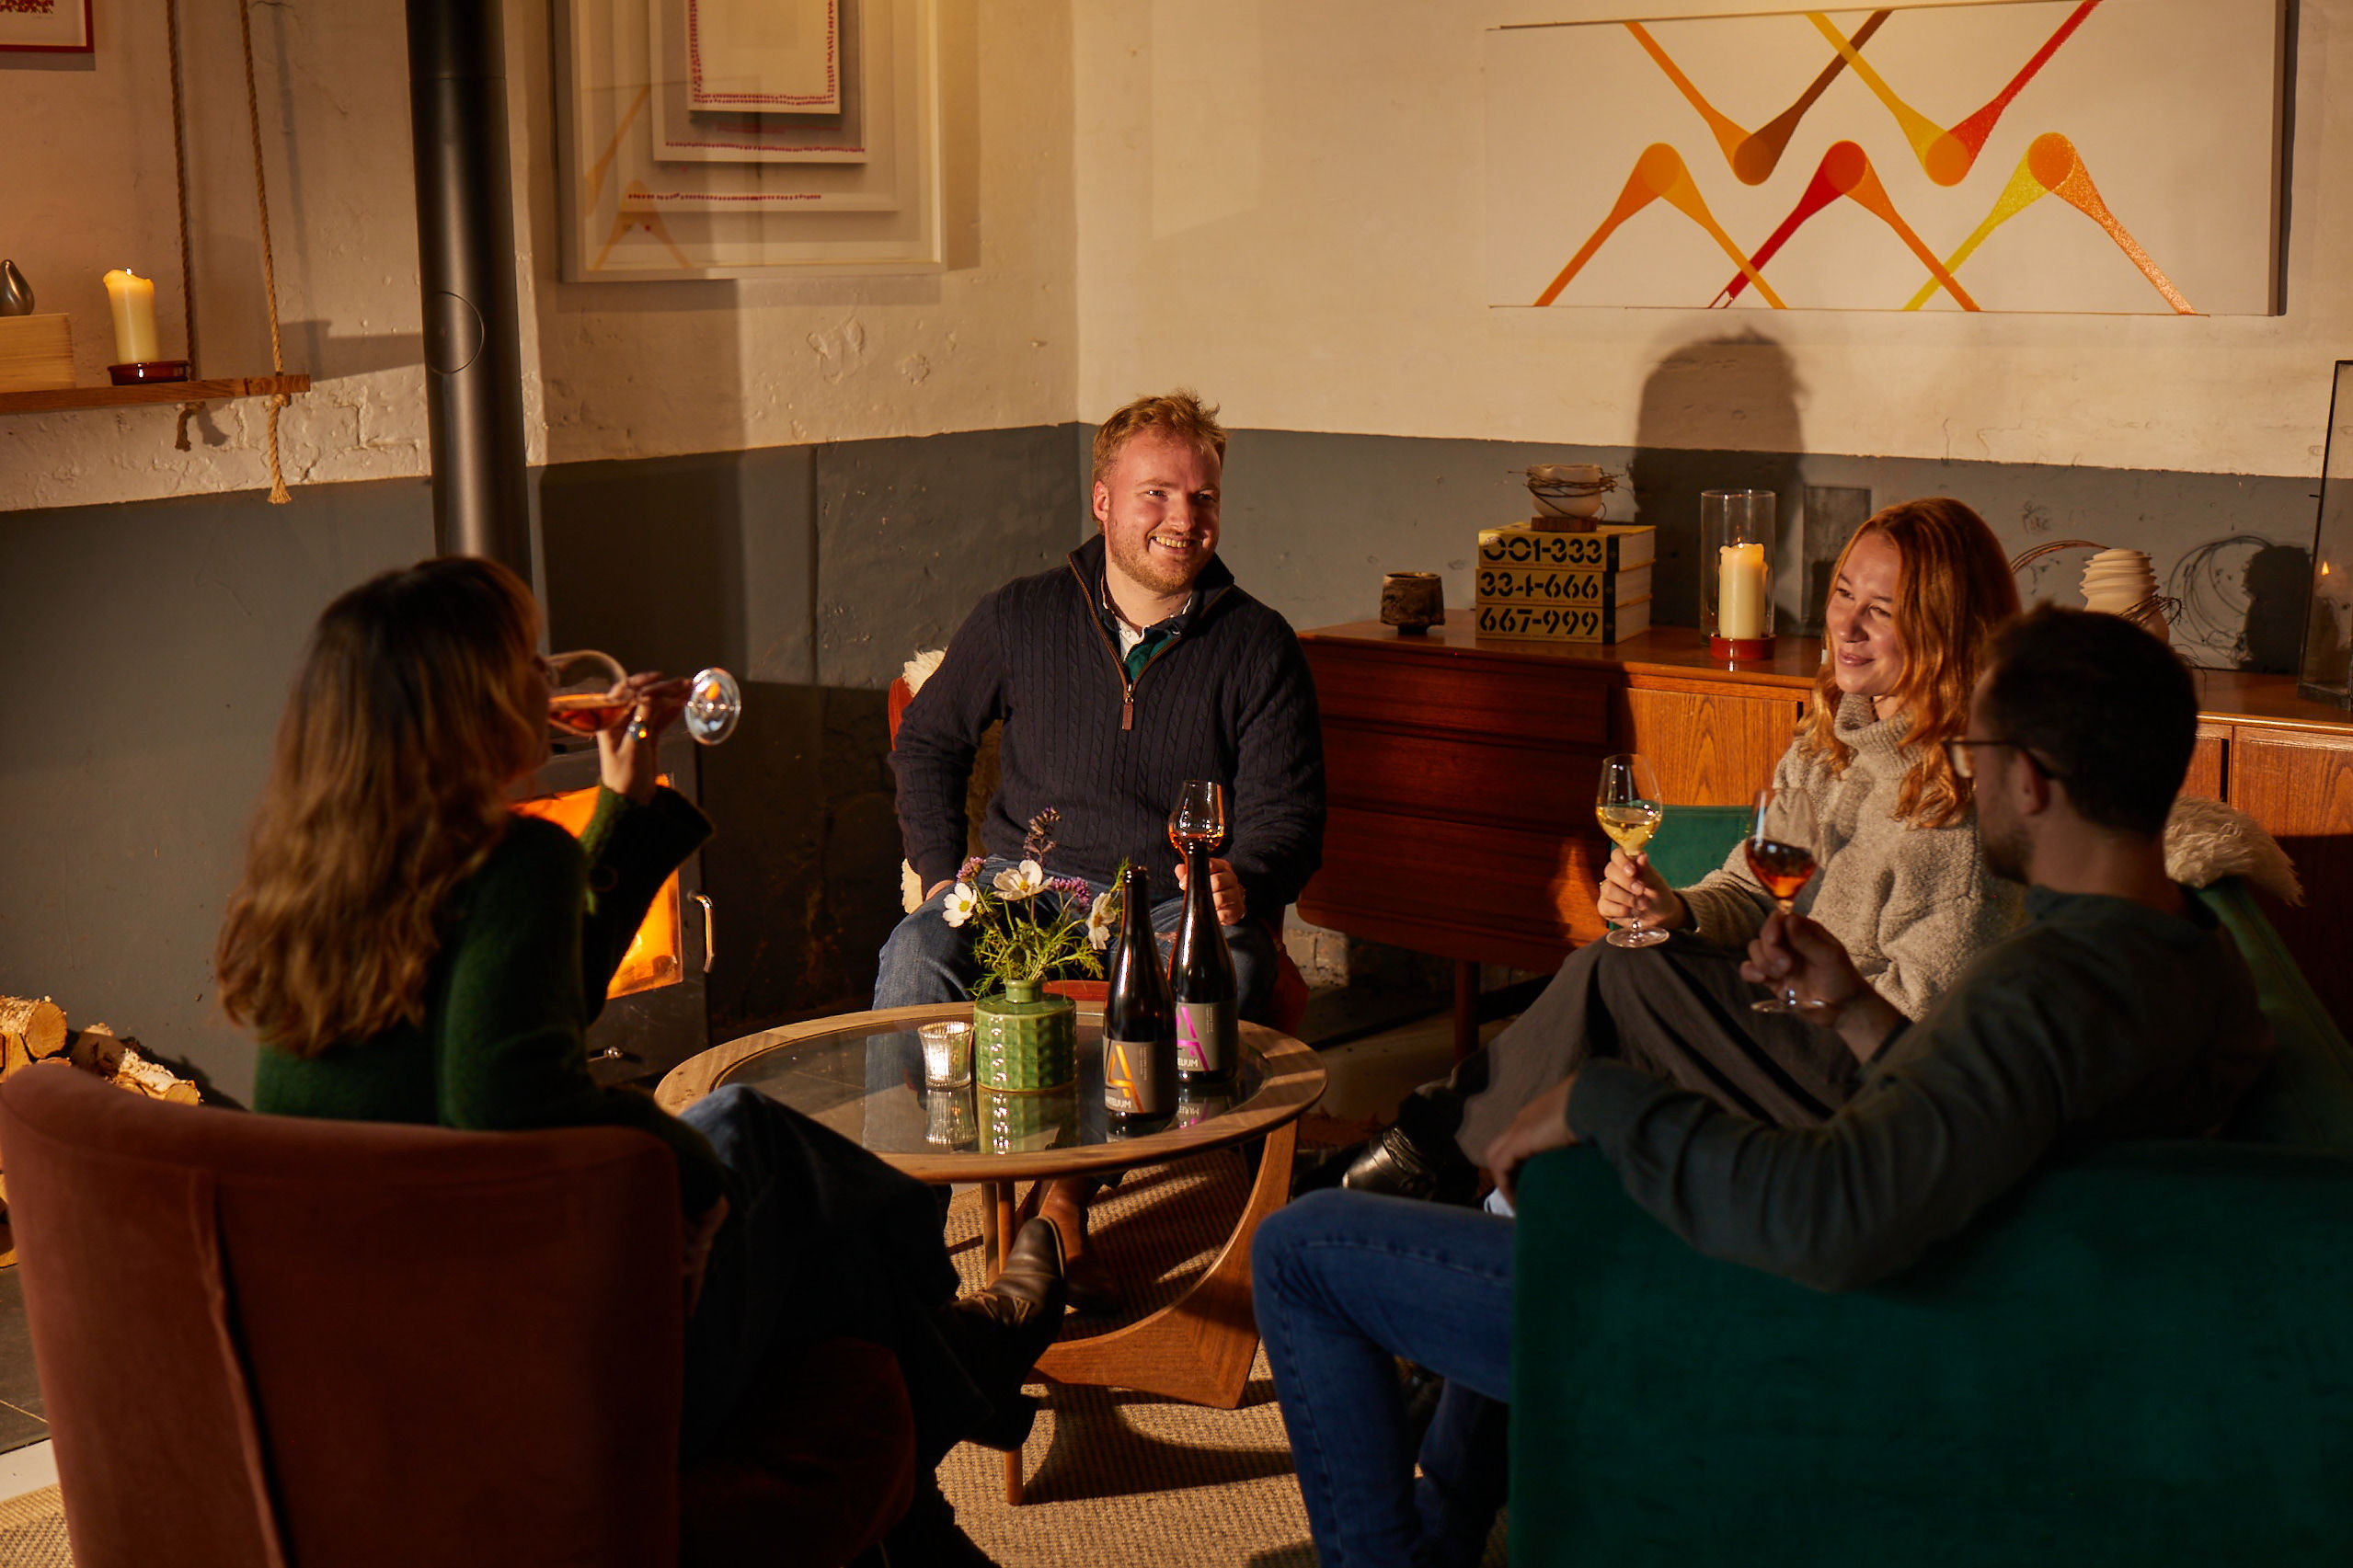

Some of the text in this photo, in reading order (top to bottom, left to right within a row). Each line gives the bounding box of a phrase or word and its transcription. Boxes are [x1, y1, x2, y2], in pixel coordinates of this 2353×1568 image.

[1483, 536, 1602, 564] 001-333
[1480, 571, 1599, 599] 334-666
[1479, 607, 1599, 635] 667-999
